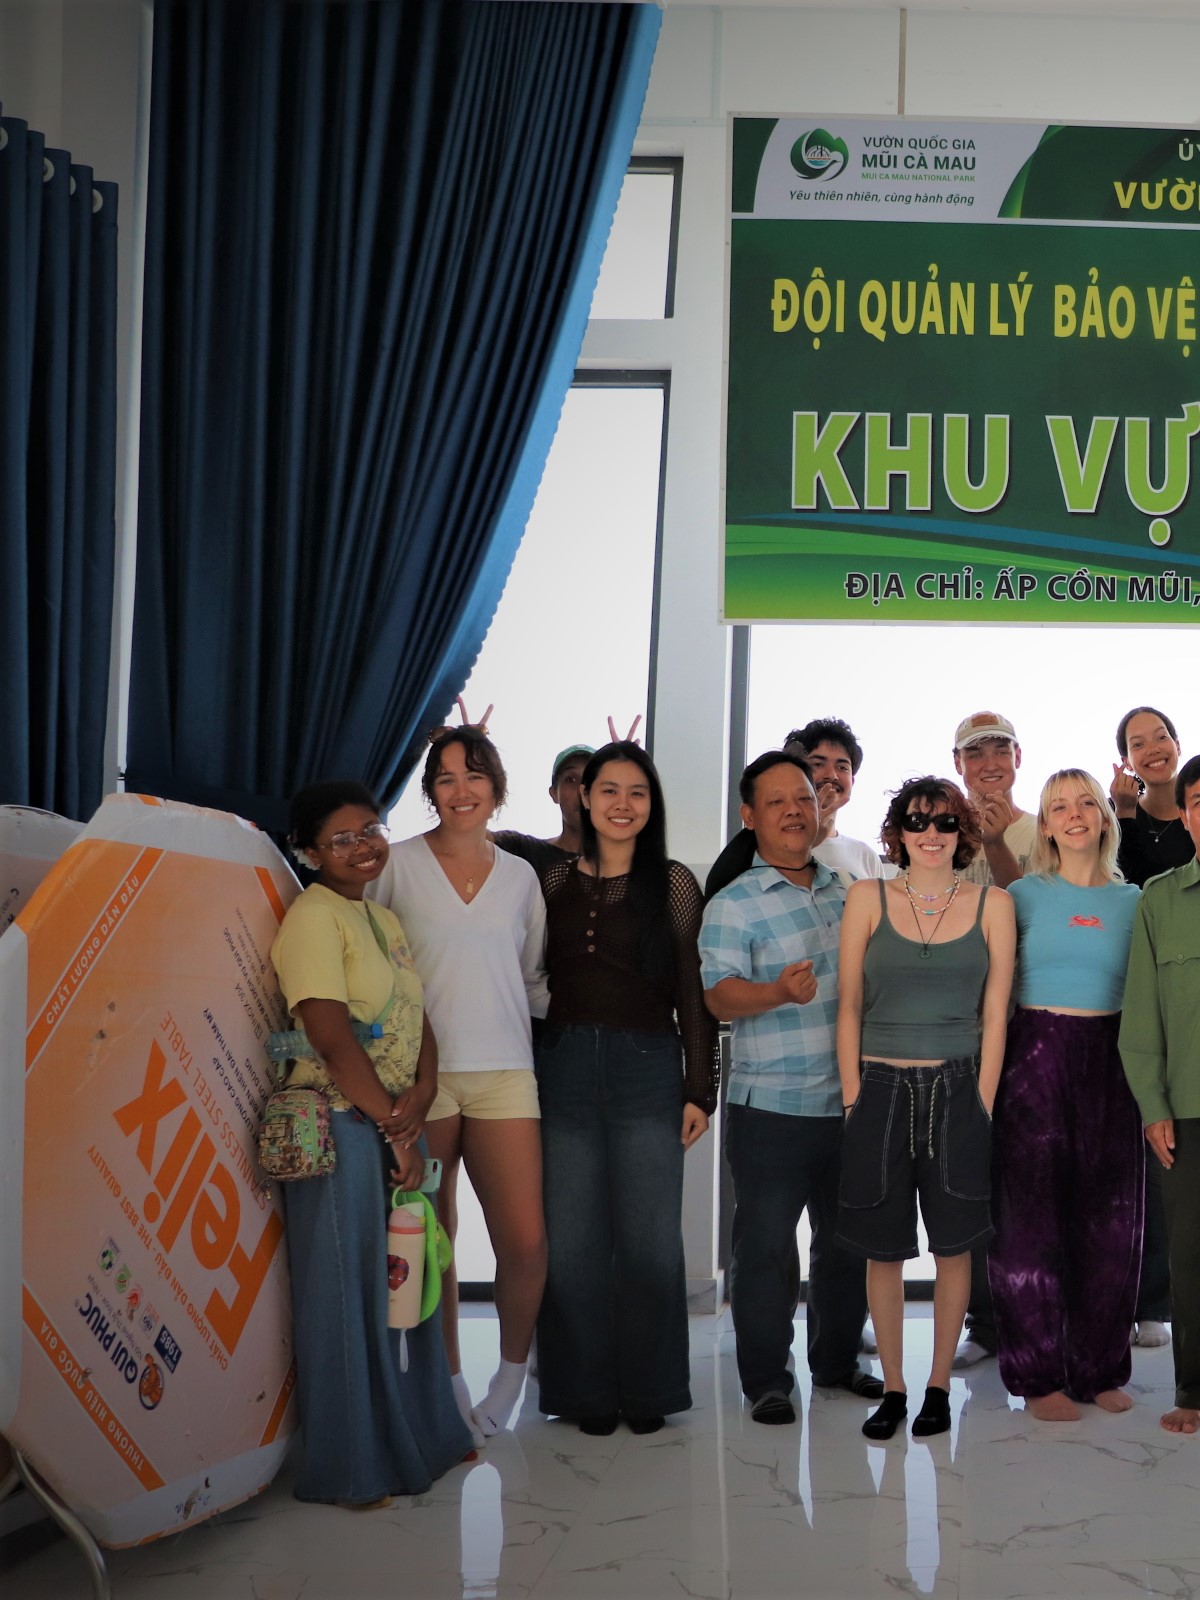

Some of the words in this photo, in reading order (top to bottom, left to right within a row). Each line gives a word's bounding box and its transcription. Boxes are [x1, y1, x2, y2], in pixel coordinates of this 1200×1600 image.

[862, 151, 898, 168] MŨI
[903, 154, 928, 170] CÀ
[934, 155, 976, 171] MAU
[863, 135, 904, 149] VƯỜN
[908, 135, 949, 151] QUỐC
[952, 139, 976, 150] GIA
[789, 190, 810, 201] Yêu
[814, 190, 843, 201] thiên
[846, 191, 881, 203] nhiên,
[884, 192, 912, 204] cùng
[914, 193, 943, 204] hành
[946, 193, 975, 206] động
[912, 174, 951, 182] NATIONAL
[771, 267, 845, 350] ĐỘI
[859, 263, 975, 343] QUẢN
[989, 271, 1033, 336] LÝ
[1054, 267, 1136, 339] BẢO
[1146, 276, 1197, 357] VỆ
[791, 411, 1010, 513] KHU
[845, 572, 906, 606] ĐỊA
[915, 565, 984, 600] CHỈ:
[993, 567, 1037, 601] ẤP
[1047, 568, 1118, 603] CỒN
[161, 1011, 193, 1076] TABLE
[193, 1067, 223, 1127] STEEL
[88, 1144, 122, 1199] QUALITY
[220, 1122, 266, 1211] STAINLESS
[113, 1037, 285, 1358] Felix
[119, 1195, 139, 1228] BEST
[137, 1225, 152, 1250] THE
[40, 1320, 58, 1350] GIA
[159, 1330, 180, 1362] 1985
[110, 1340, 139, 1384] QUI
